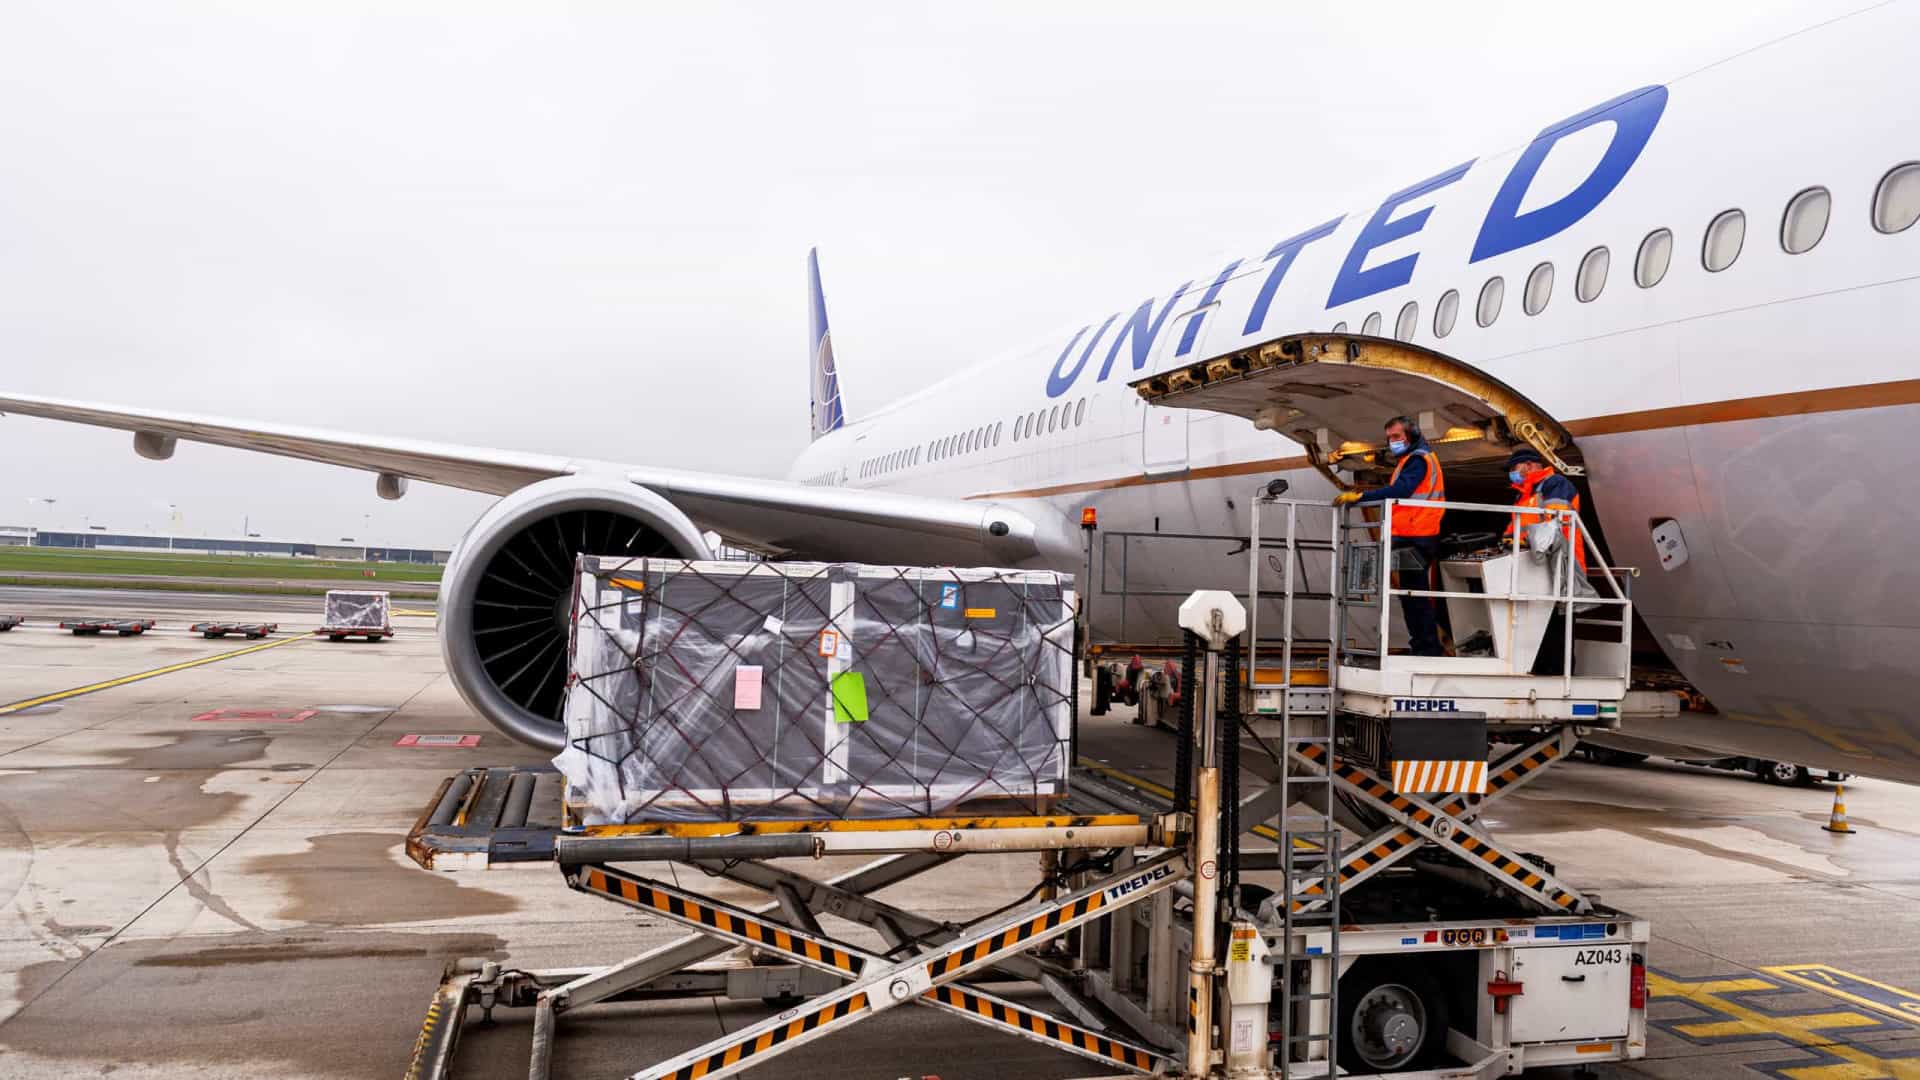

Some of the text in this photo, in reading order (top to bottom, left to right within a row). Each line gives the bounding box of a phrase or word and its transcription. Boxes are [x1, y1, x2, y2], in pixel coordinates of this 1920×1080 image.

[1046, 84, 1669, 397] UNITED
[1393, 699, 1459, 712] TREPEL
[1108, 864, 1175, 898] TREPEL
[1444, 928, 1484, 946] TCR
[1575, 950, 1621, 965] AZ043
